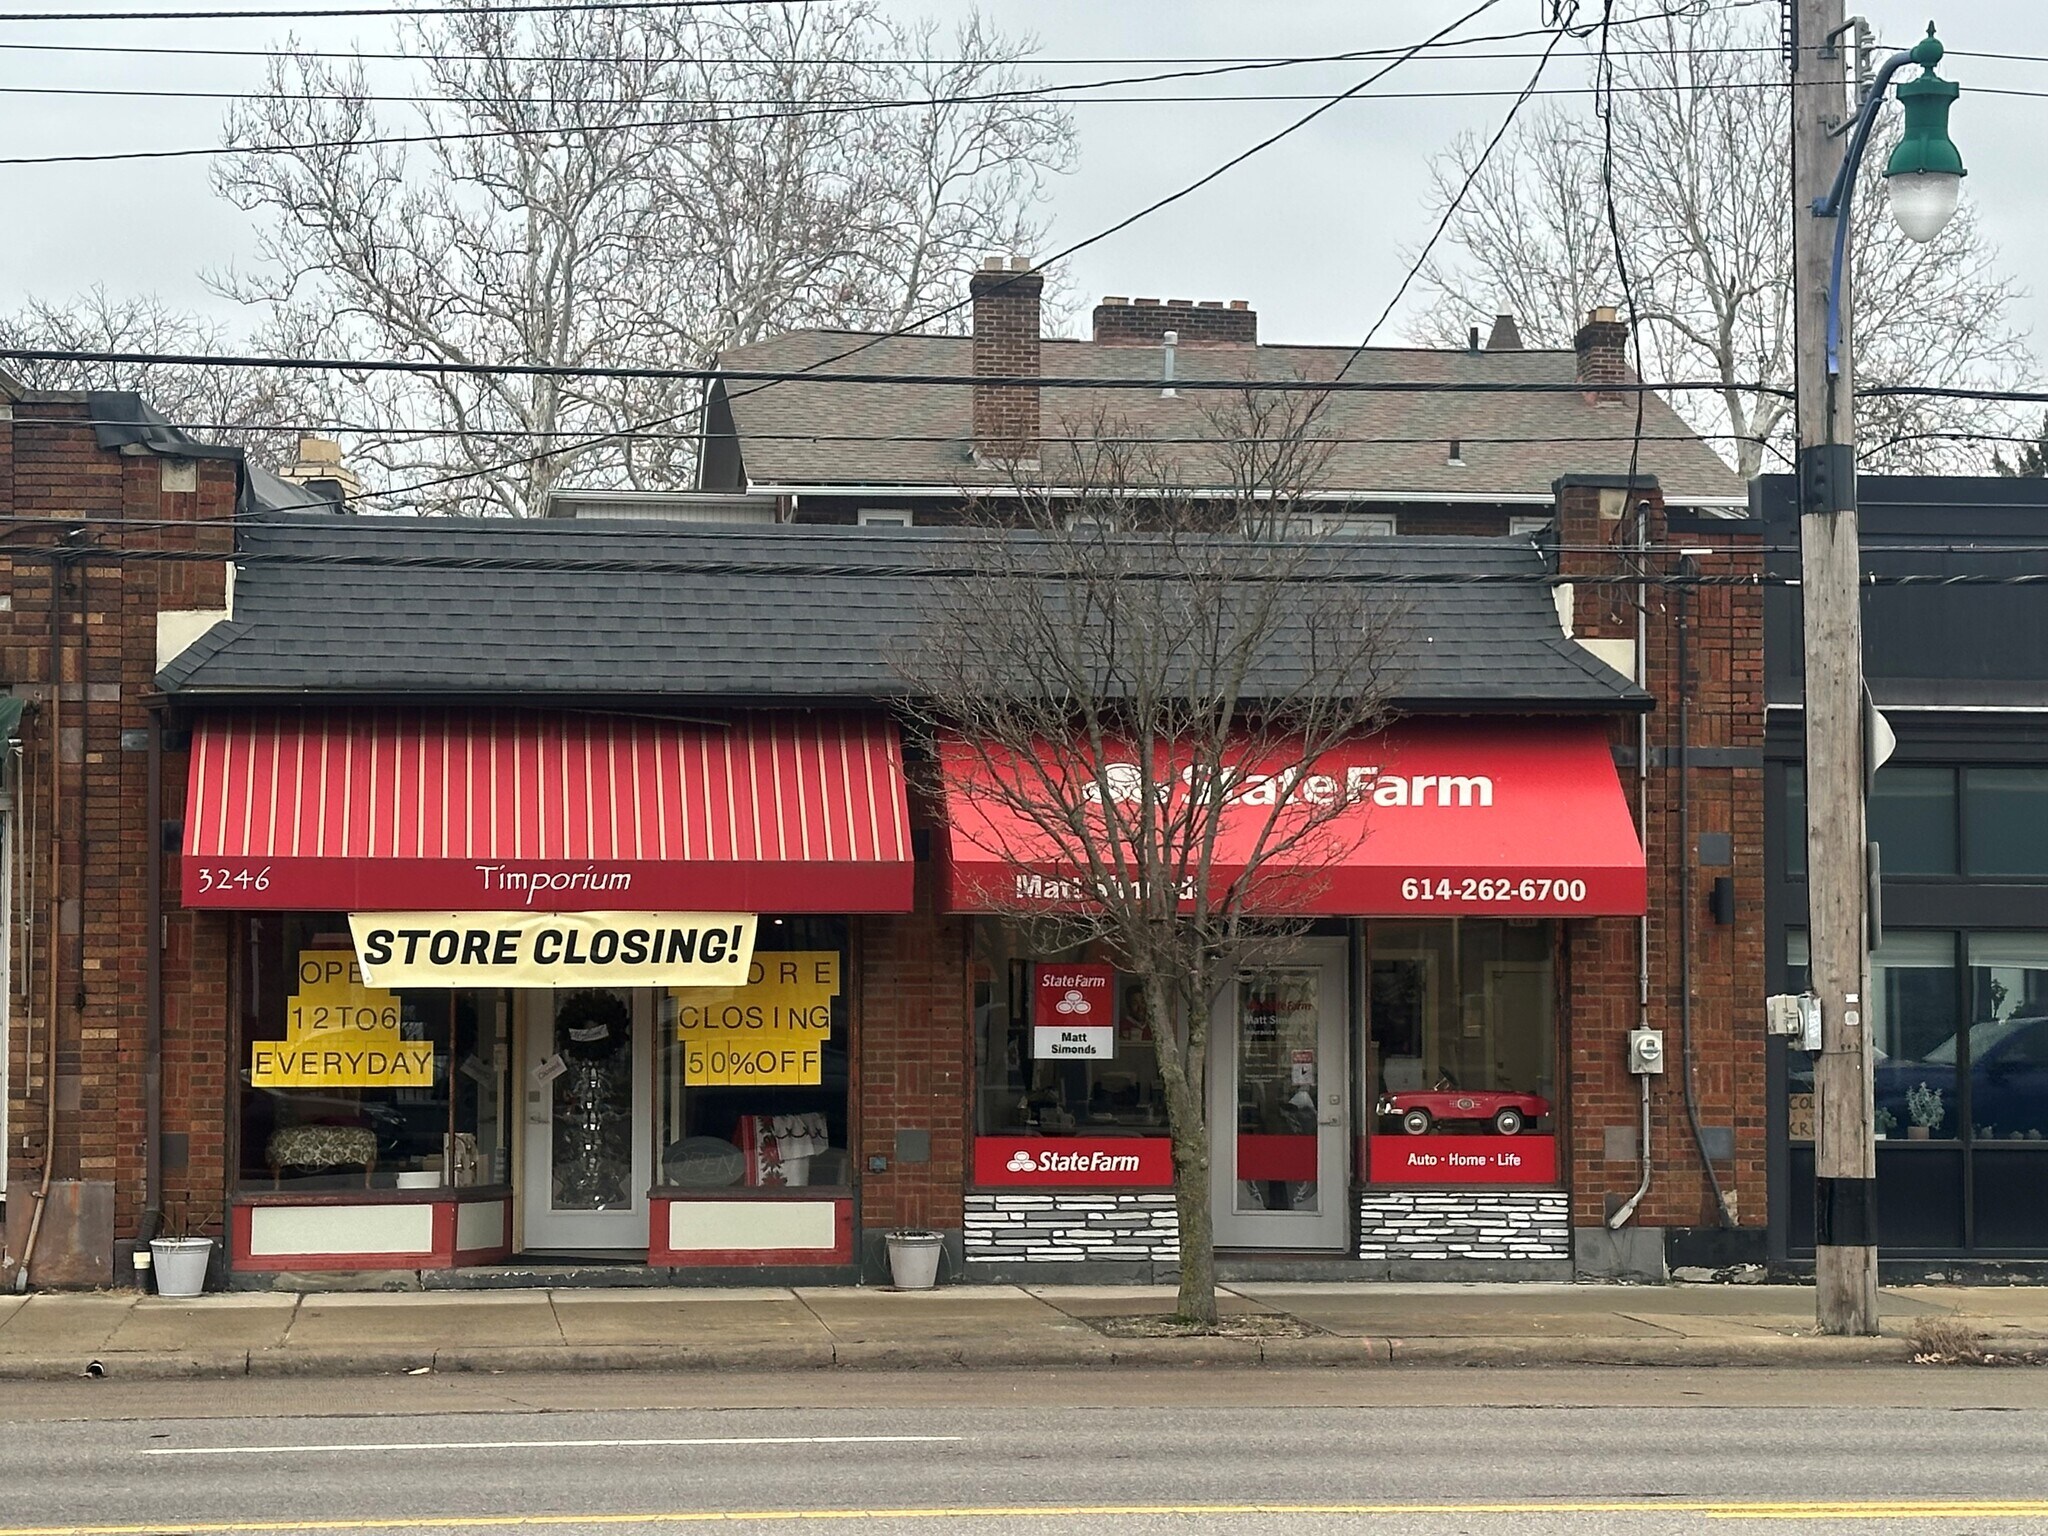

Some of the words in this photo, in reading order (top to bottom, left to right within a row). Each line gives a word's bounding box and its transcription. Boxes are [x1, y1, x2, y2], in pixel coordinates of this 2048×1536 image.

[198, 865, 272, 894] 3246
[475, 864, 632, 905] Timporium
[1402, 877, 1587, 901] 614-262-6700
[364, 929, 522, 966] STORE
[533, 925, 744, 965] CLOSING!
[300, 961, 363, 984] OPE
[748, 961, 832, 985] ORE
[679, 1006, 829, 1030] CLOSING
[1244, 1015, 1267, 1025] Matt
[1051, 1044, 1097, 1054] Simonds
[1061, 1032, 1087, 1042] Matt
[255, 1051, 432, 1075] EVERYDAY
[1407, 1153, 1438, 1166] Auto
[1448, 1153, 1486, 1166] Home
[1498, 1153, 1521, 1166] Life
